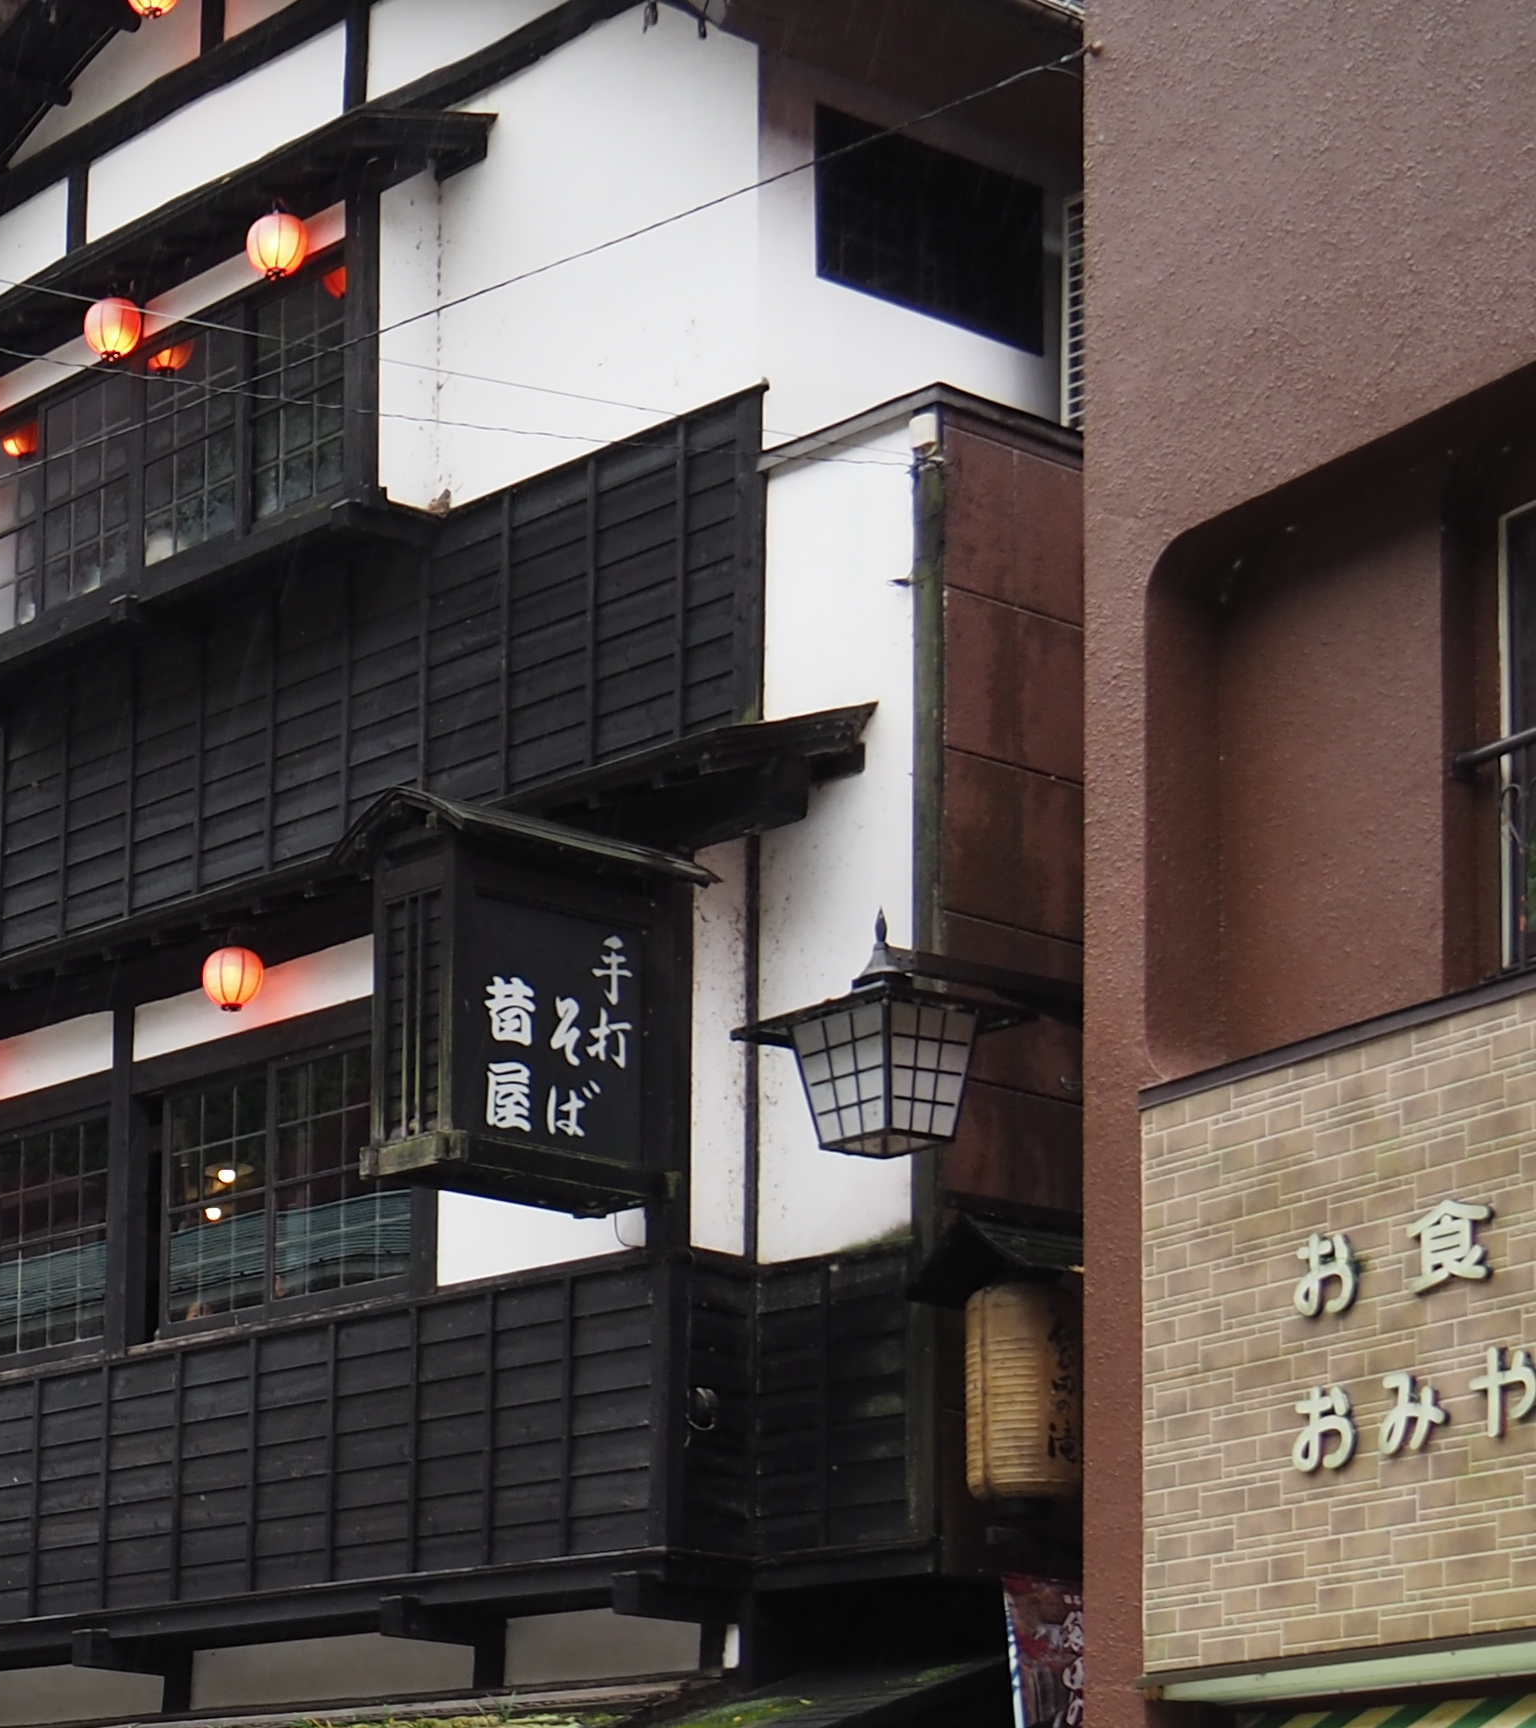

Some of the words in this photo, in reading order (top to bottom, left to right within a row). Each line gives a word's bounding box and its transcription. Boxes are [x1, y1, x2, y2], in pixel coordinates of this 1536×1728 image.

[484, 976, 536, 1133] 昔屋
[546, 996, 601, 1138] そば
[587, 936, 633, 1069] 手打
[1293, 1198, 1492, 1318] お食
